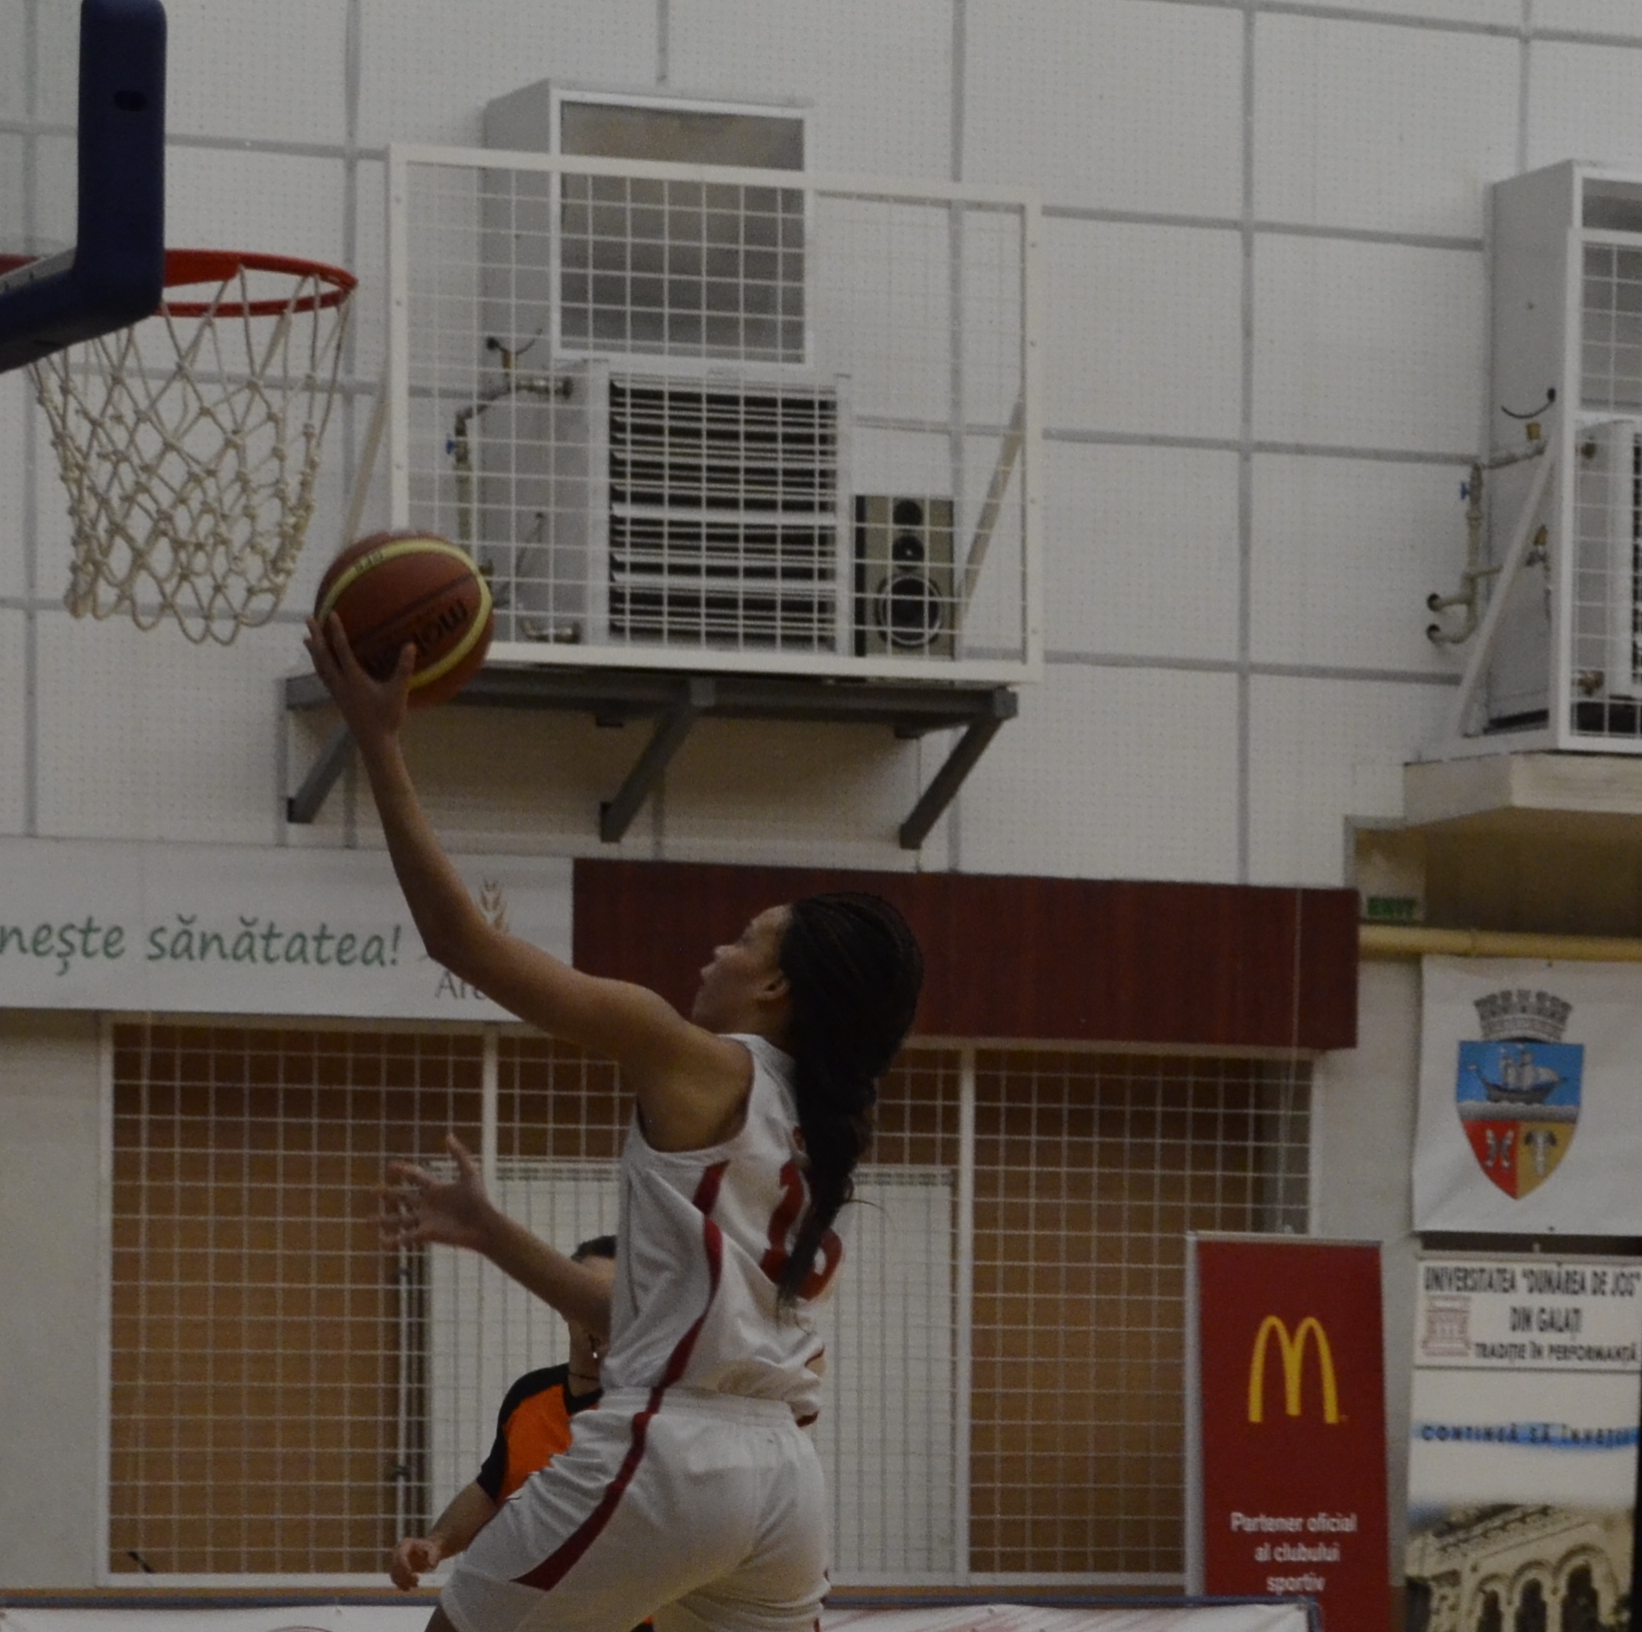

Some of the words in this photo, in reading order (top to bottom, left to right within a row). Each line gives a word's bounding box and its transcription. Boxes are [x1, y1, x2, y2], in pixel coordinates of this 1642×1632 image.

[147, 909, 403, 970] sănătatea!
[1230, 1512, 1304, 1534] Partener
[1307, 1512, 1358, 1534] oficial
[1254, 1543, 1271, 1562] al
[1273, 1543, 1341, 1563] clubului
[1266, 1572, 1325, 1596] sportiv
